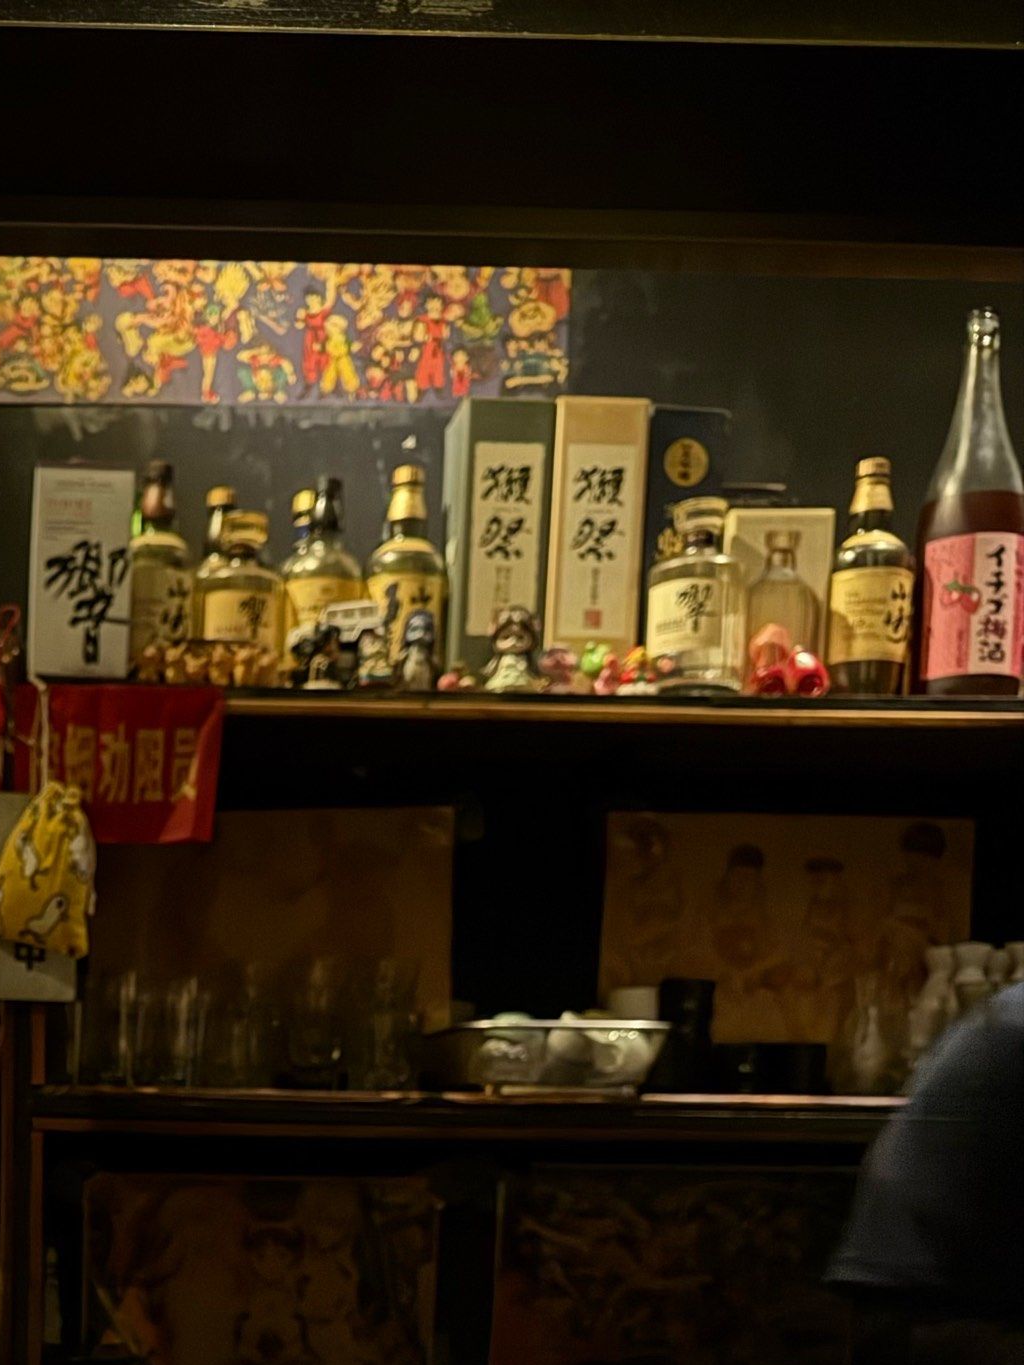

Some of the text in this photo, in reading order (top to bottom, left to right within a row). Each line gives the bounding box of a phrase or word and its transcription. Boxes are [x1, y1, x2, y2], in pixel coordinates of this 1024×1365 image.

[977, 544, 1009, 665] イチゴ梅酒
